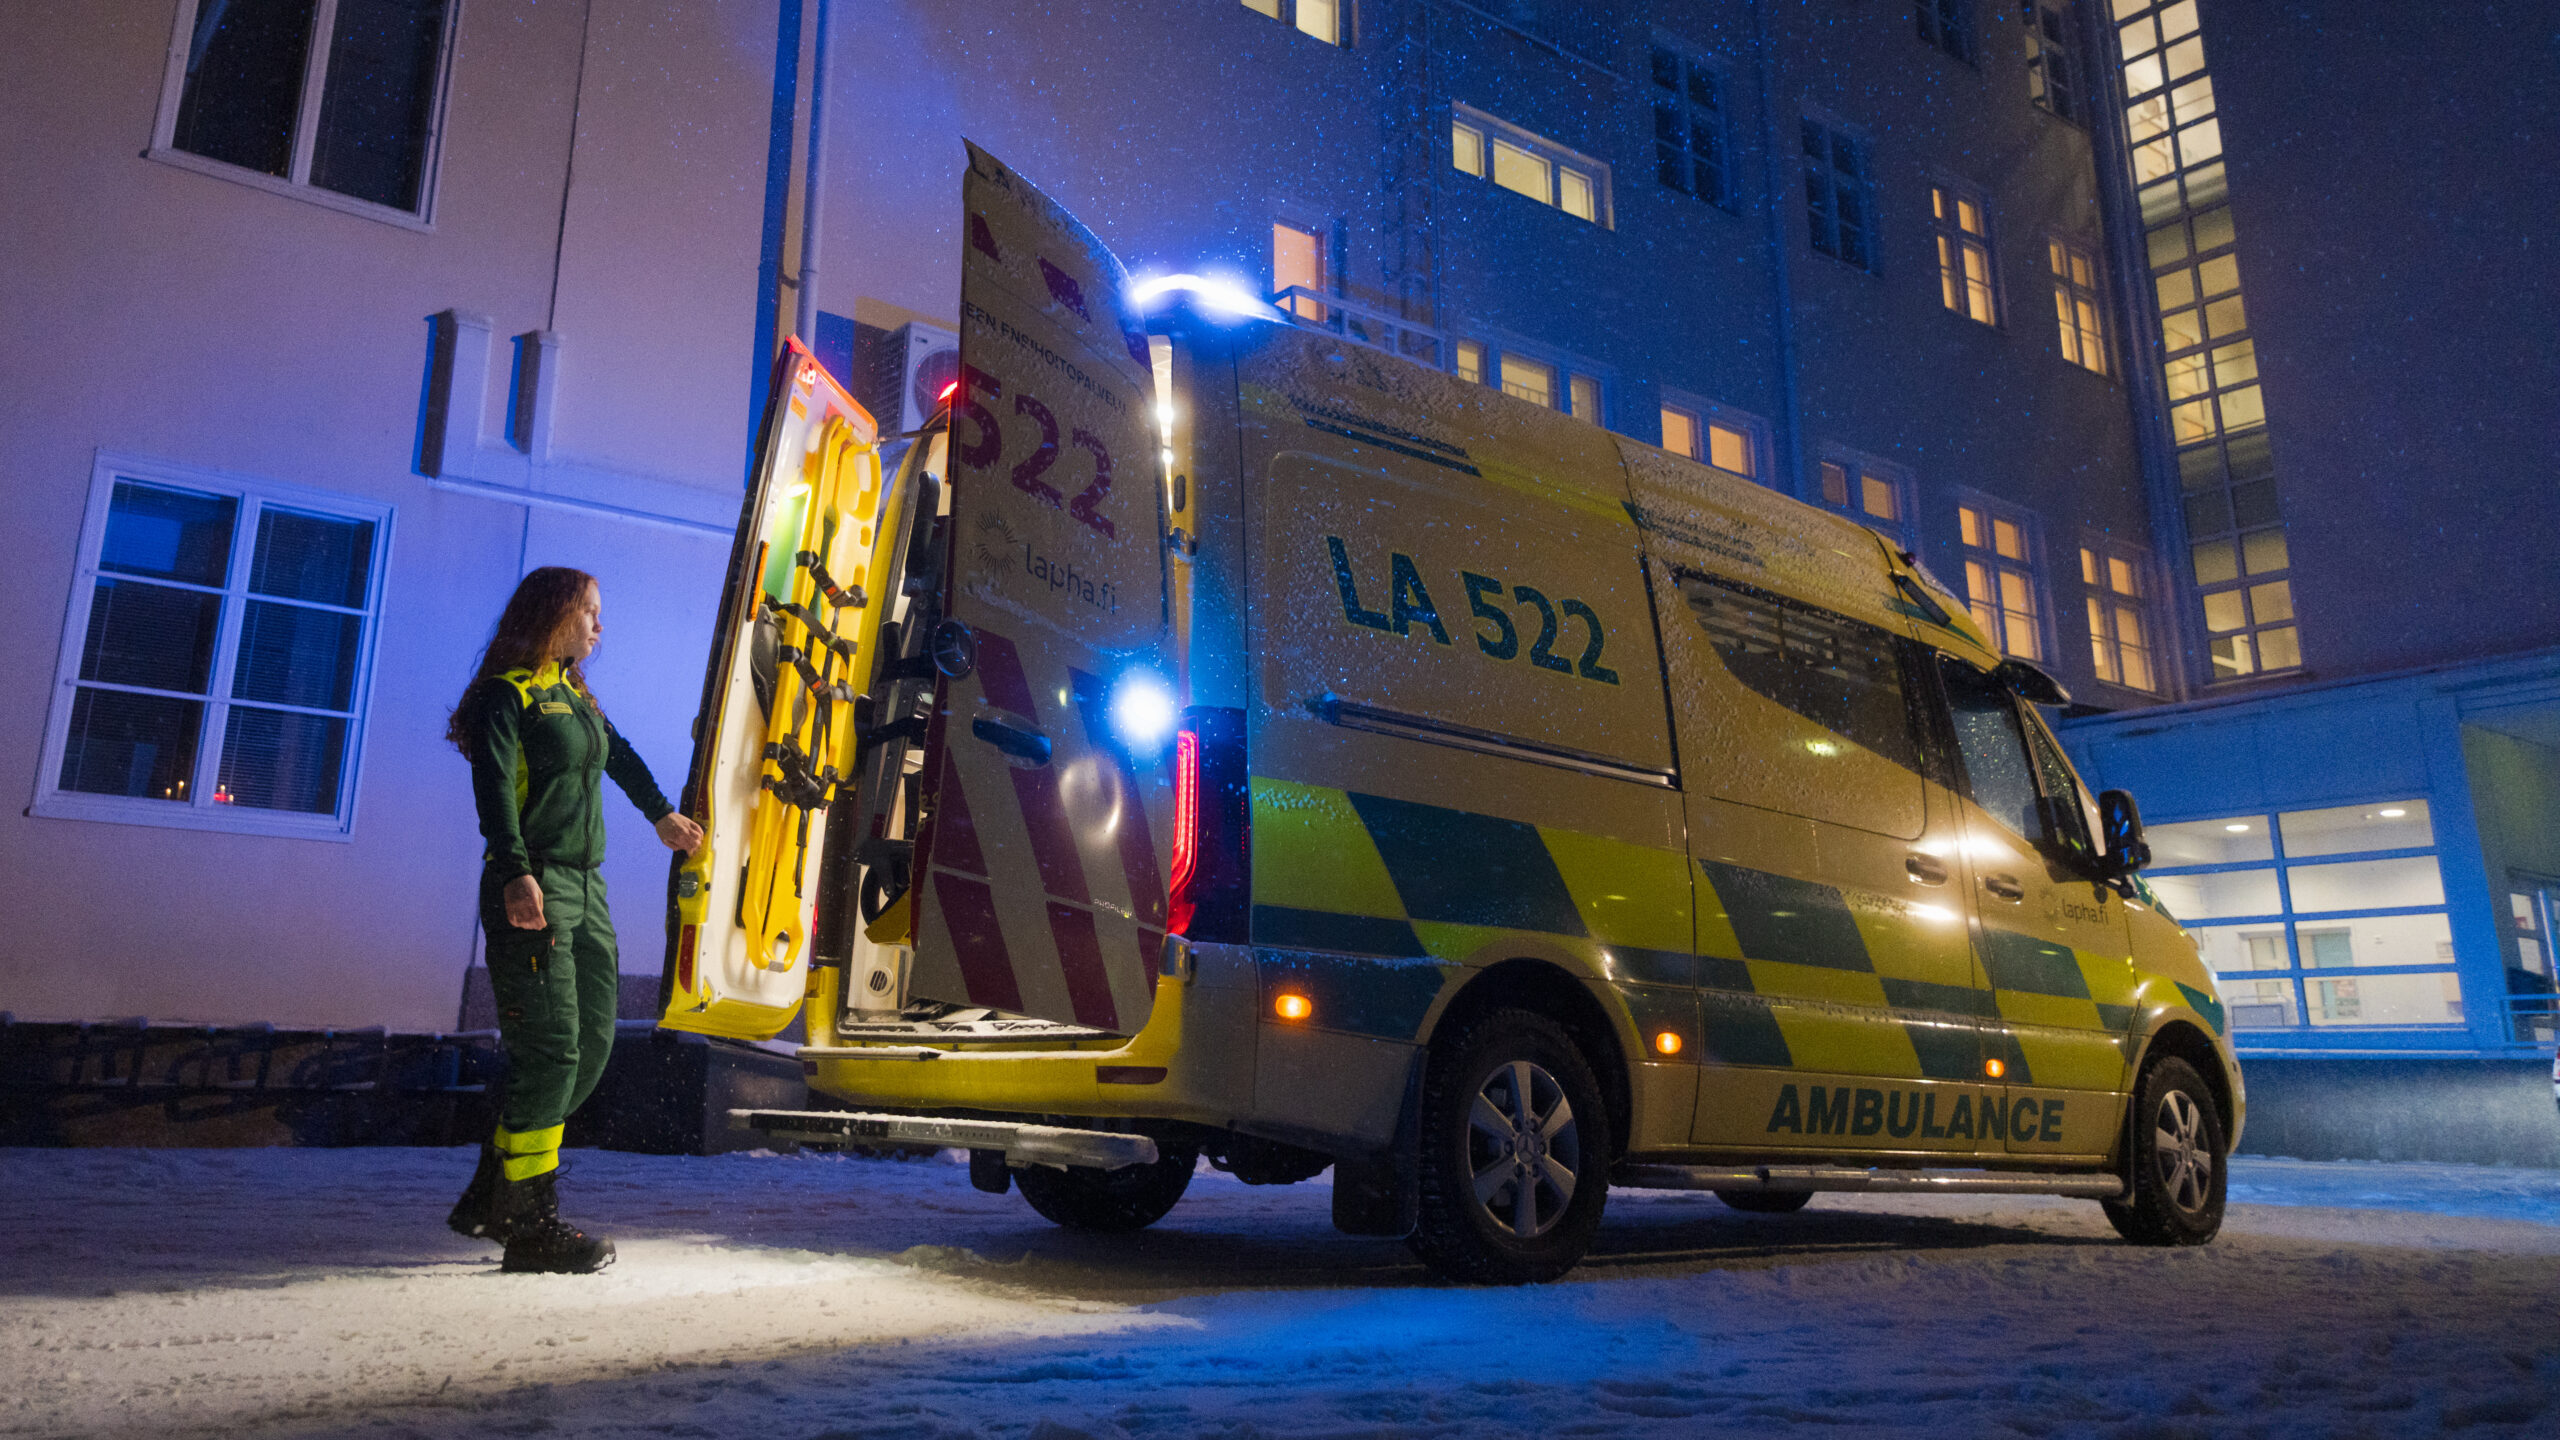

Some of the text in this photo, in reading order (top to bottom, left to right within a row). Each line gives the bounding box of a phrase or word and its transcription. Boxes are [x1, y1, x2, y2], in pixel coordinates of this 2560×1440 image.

[960, 362, 1115, 541] 522
[1025, 543, 1117, 615] lapha.fi
[1326, 535, 1621, 687] LA 522
[2061, 897, 2110, 926] lapha.fi
[1766, 1083, 2066, 1143] AMBULANCE
